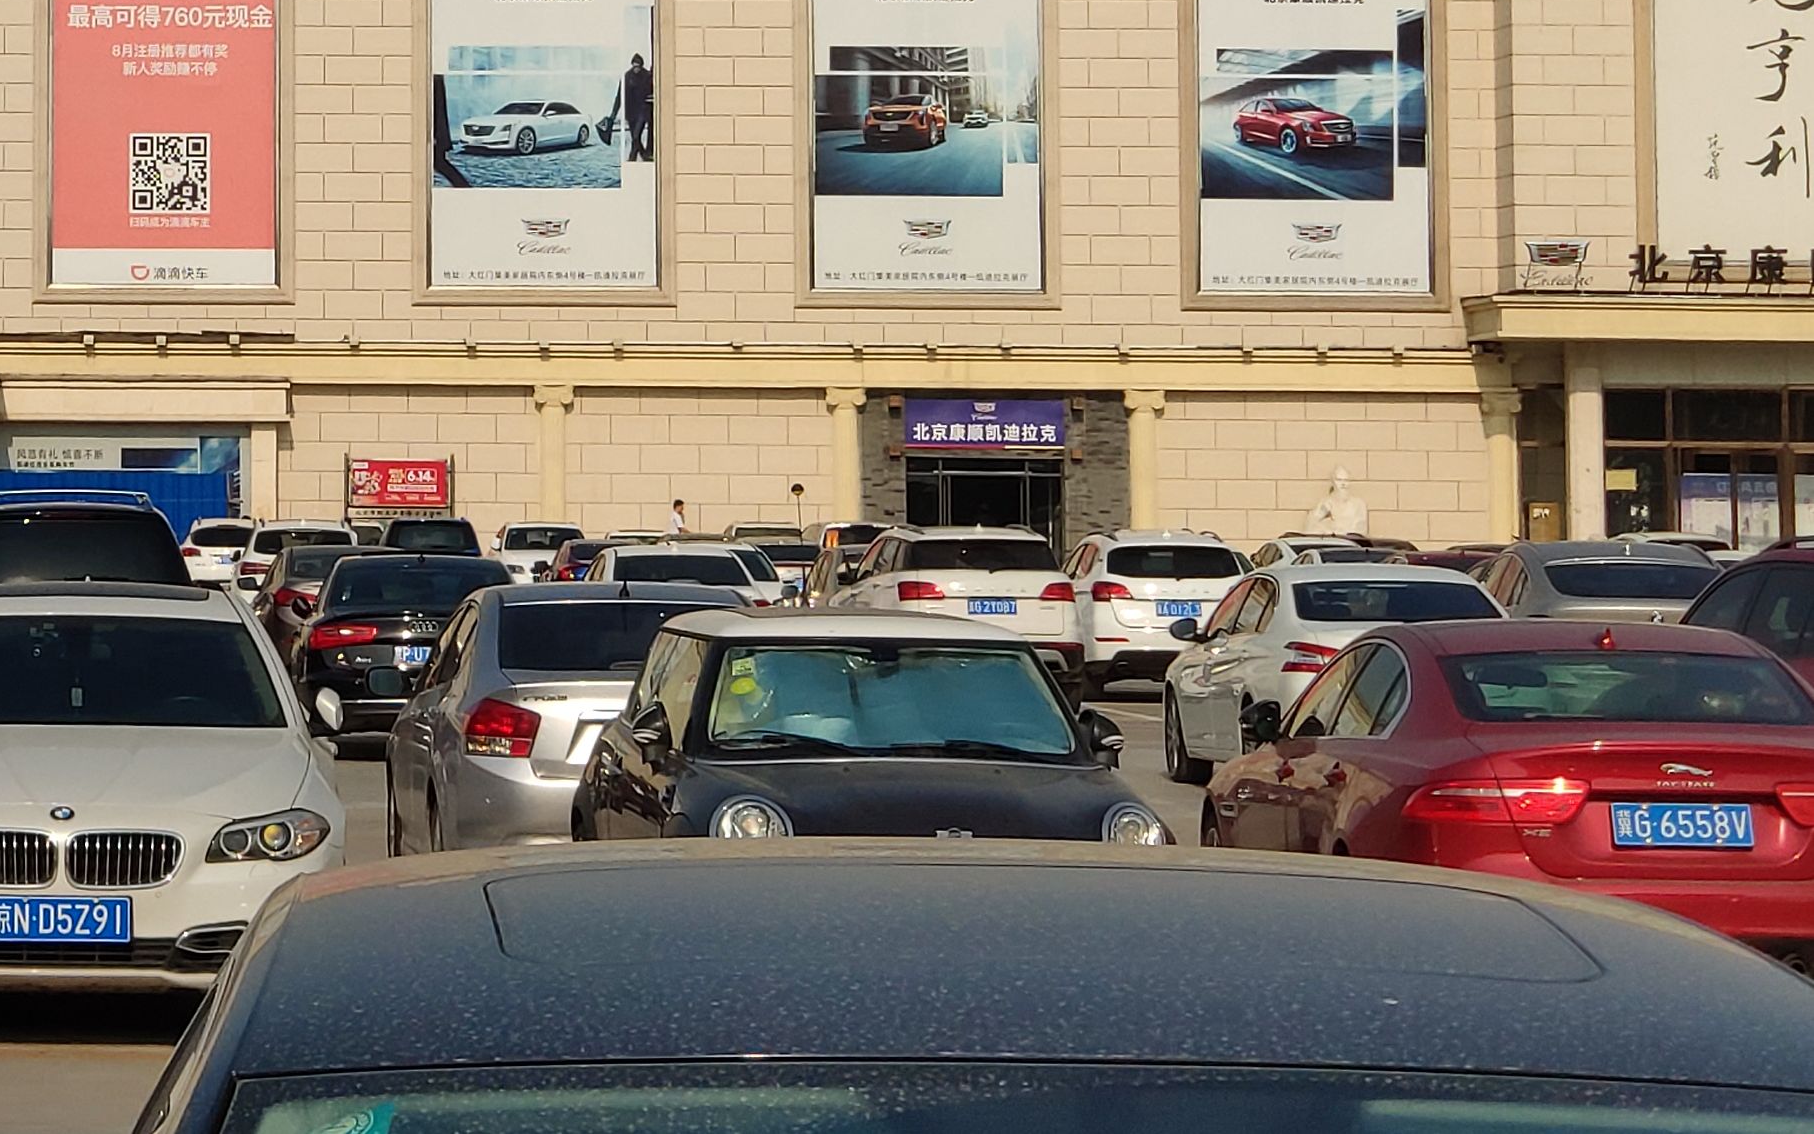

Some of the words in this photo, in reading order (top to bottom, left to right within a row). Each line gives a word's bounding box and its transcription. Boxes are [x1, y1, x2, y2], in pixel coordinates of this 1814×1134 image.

[67, 4, 274, 29] 最高可得760元现金
[153, 266, 208, 281] 滴滴快车
[1629, 243, 1814, 283] 北京康
[912, 423, 1057, 442] 北京康顺凯迪拉克
